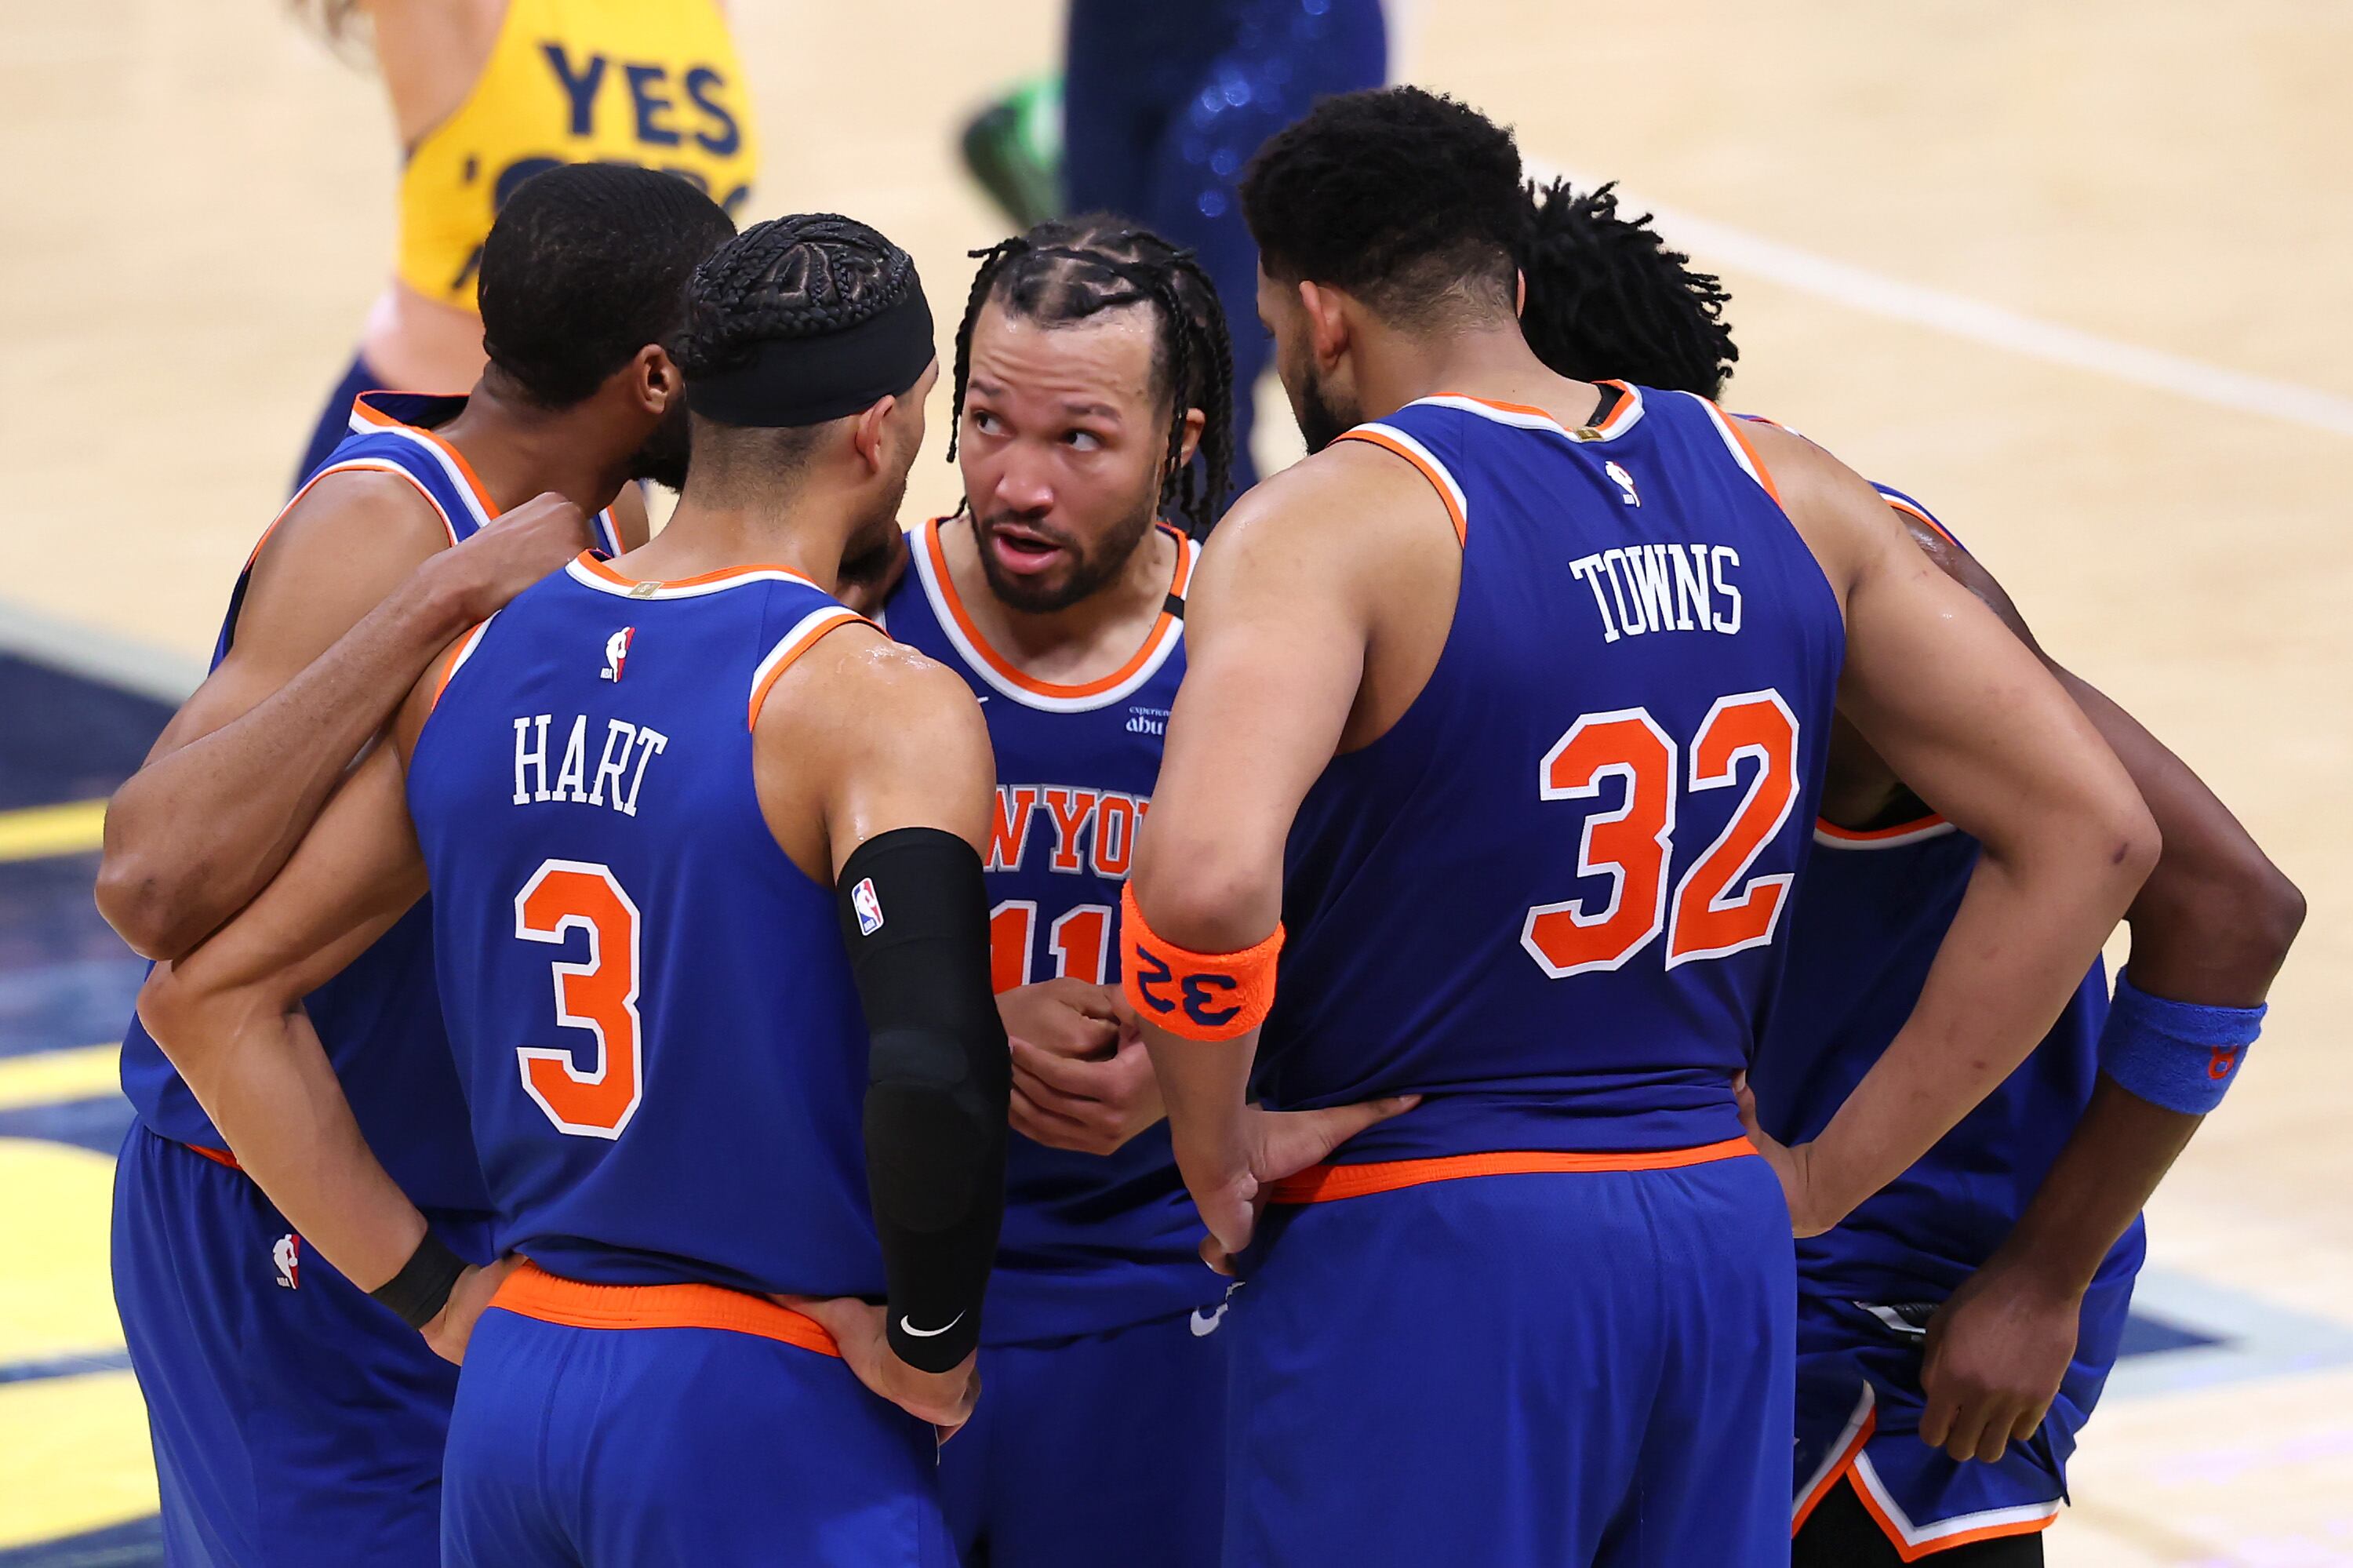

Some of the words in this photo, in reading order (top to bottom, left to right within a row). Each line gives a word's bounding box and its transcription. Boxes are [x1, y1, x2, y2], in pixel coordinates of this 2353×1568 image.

[543, 44, 739, 155] YES
[1569, 543, 1742, 644] TOWNS
[512, 714, 668, 817] HART
[1126, 716, 1162, 735] abu
[1041, 784, 1150, 880] YO
[1520, 687, 1800, 979] 32
[991, 900, 1111, 995] 11
[514, 858, 642, 1141] 3
